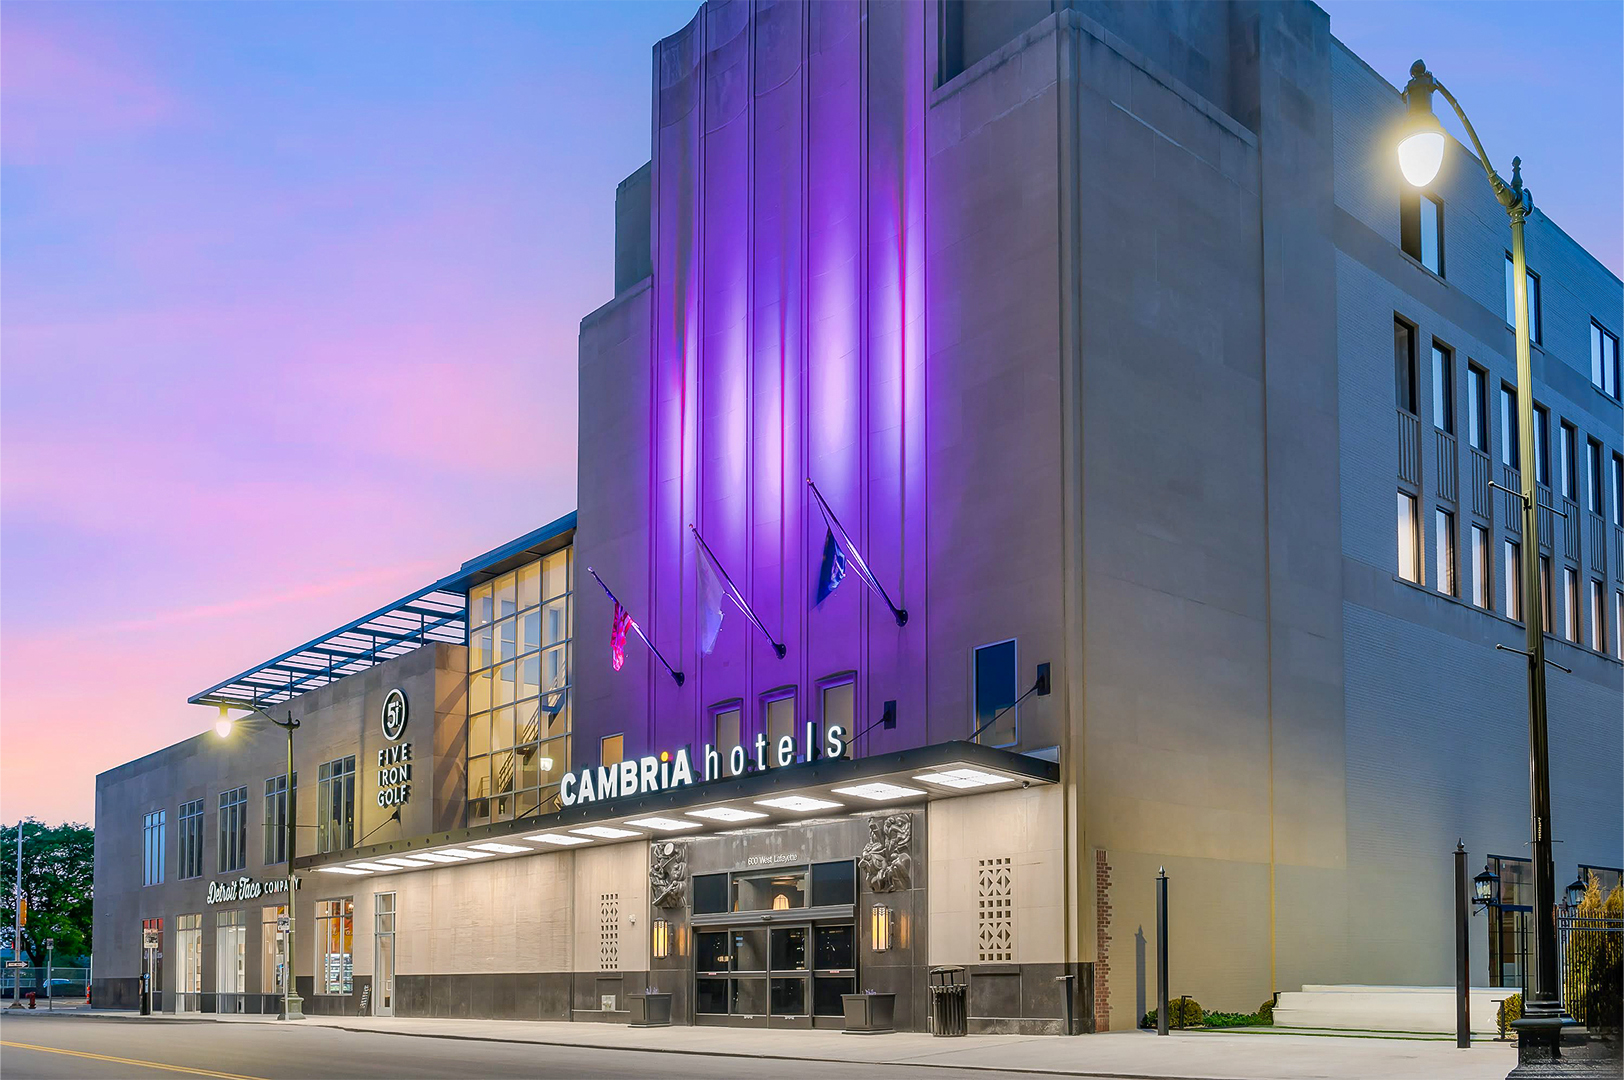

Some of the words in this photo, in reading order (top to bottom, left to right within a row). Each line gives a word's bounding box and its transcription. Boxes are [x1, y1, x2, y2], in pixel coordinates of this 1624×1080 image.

[378, 743, 409, 767] FIVE
[705, 721, 847, 782] hotels
[377, 764, 409, 787] IRON
[377, 784, 408, 807] GOLF
[747, 857, 758, 866] 600
[760, 855, 773, 864] West
[206, 880, 239, 905] Detroit
[238, 876, 263, 901] Taco
[264, 878, 300, 894] COMPAY
